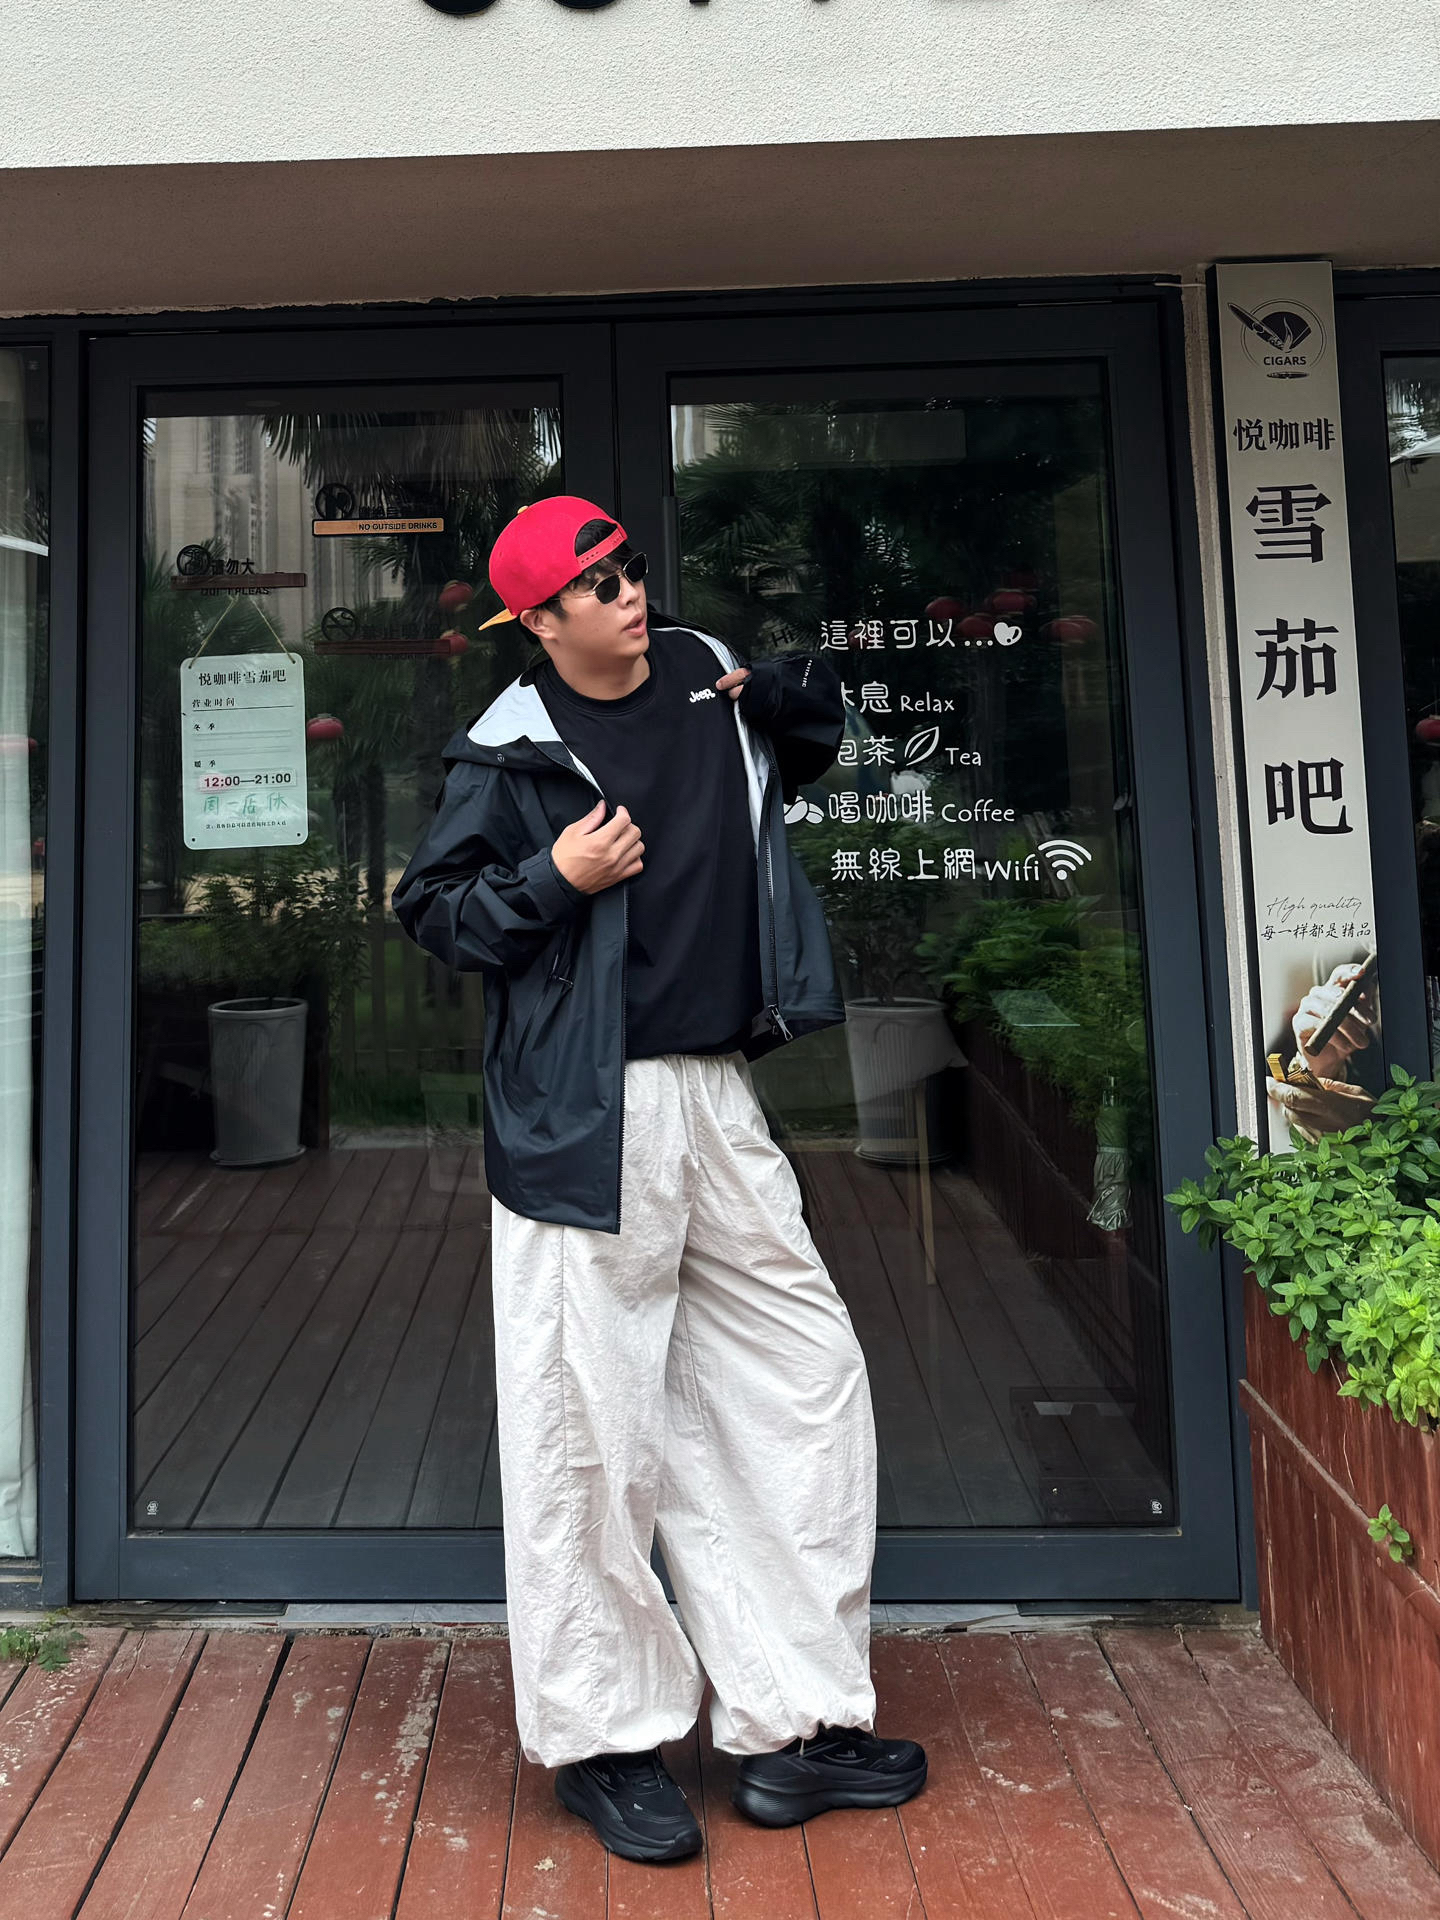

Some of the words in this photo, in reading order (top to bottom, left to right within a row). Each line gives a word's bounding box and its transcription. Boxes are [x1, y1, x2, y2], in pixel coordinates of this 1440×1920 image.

[1263, 355, 1307, 367] CIGARS
[1232, 417, 1336, 453] 悦咖啡
[358, 523, 370, 531] NO
[372, 522, 406, 530] OUTSIDE
[408, 521, 438, 529] DRINKS
[1245, 482, 1354, 837] 雪茄吧
[198, 669, 287, 687] 悦咖啡雪茄吧
[192, 697, 236, 708] 营业时间
[900, 692, 955, 714] Relax
[945, 747, 982, 767] Tea
[828, 790, 936, 824] 喝咖啡
[941, 798, 1015, 823] Coffee
[831, 847, 976, 882] 無線上網
[985, 853, 1040, 882] Wifi
[1266, 896, 1305, 923] High
[1309, 896, 1362, 919] quality
[1260, 922, 1372, 941] 每一样都是精品
